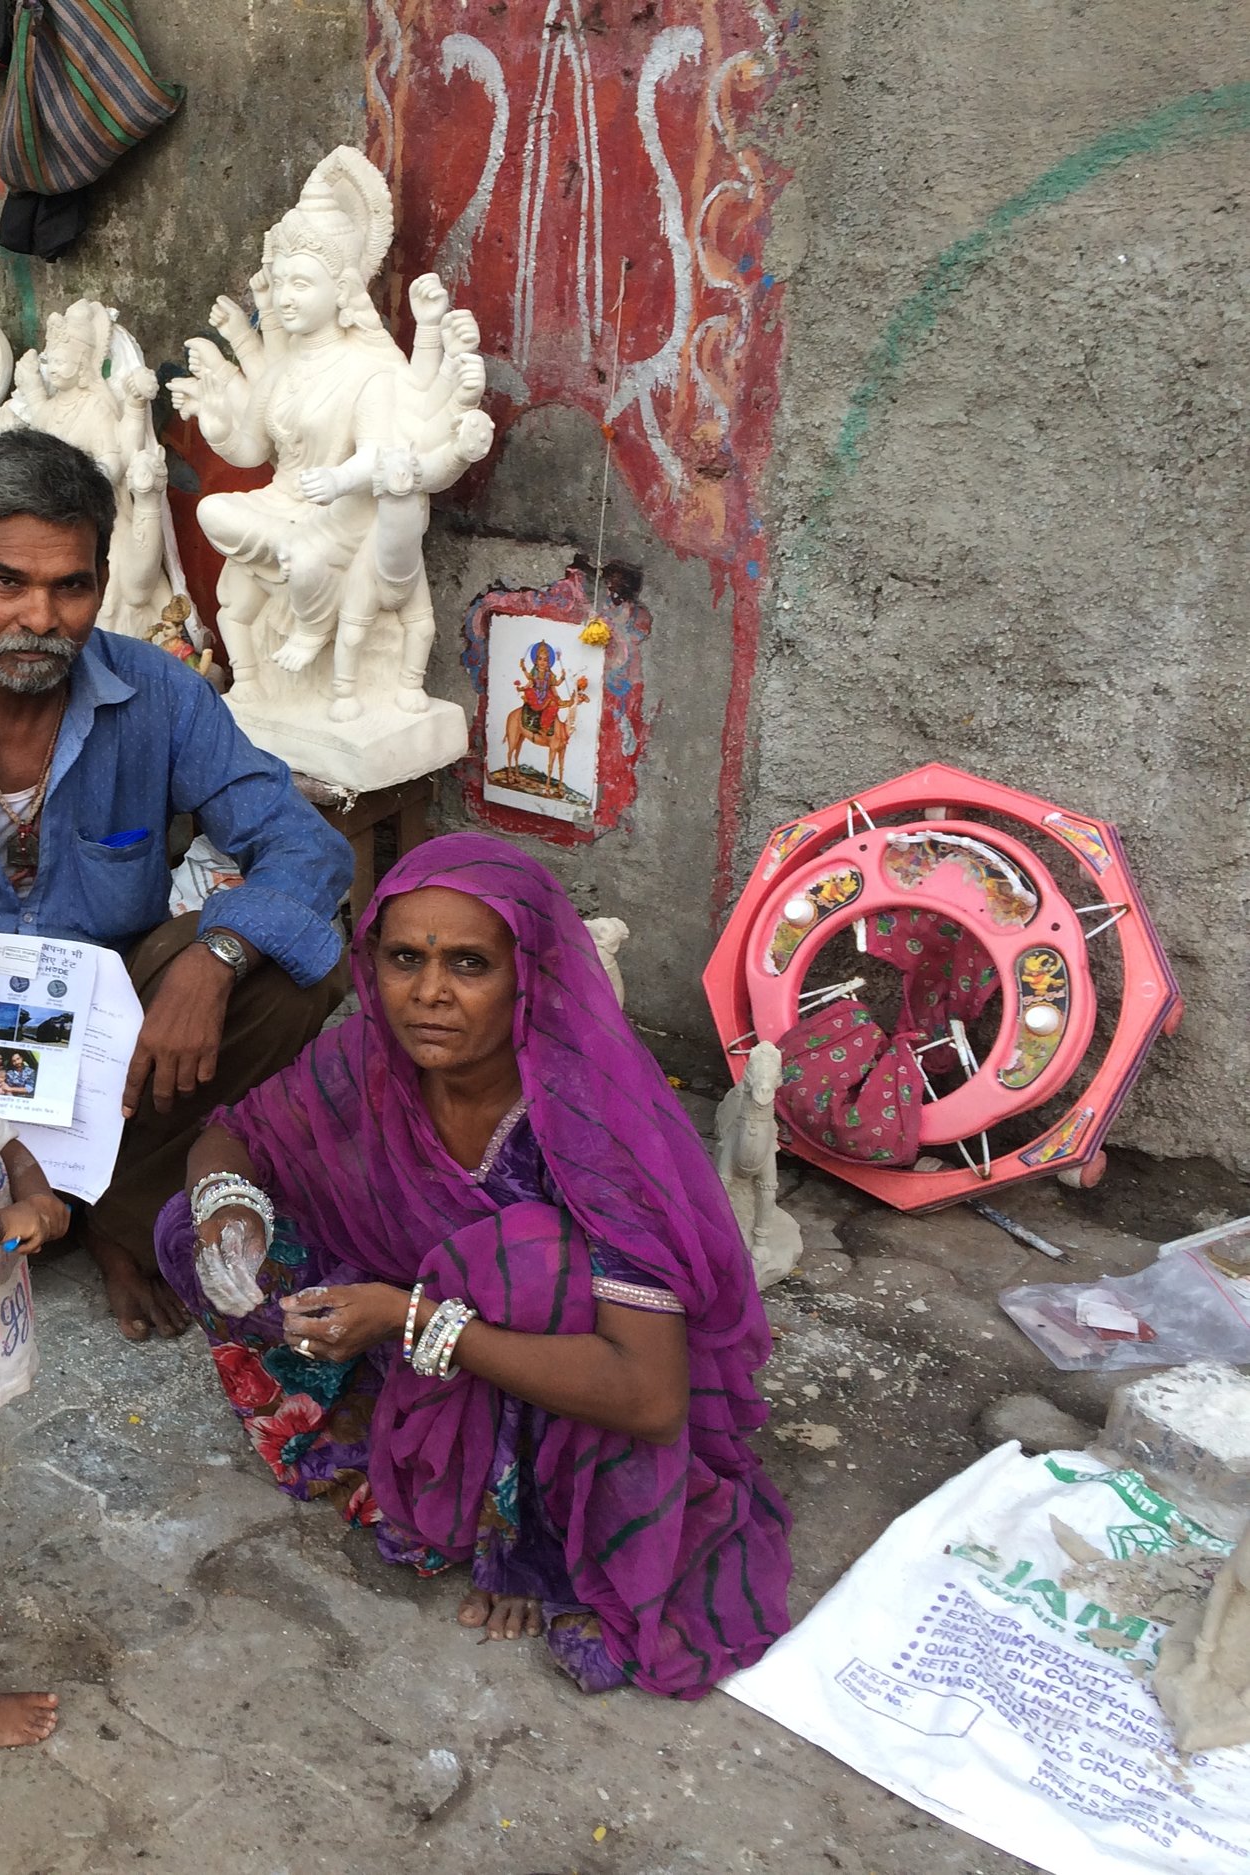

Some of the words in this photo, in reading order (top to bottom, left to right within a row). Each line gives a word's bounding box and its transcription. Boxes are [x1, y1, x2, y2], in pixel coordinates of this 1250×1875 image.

[1006, 1668, 1102, 1715] SURFACE
[1022, 1633, 1135, 1685] AESTHETIC
[1030, 1648, 1117, 1691] QUALITY
[916, 1657, 960, 1672] SETS
[1079, 1741, 1149, 1779] SAVES
[1020, 1690, 1082, 1721] LIGHT
[1045, 1668, 1160, 1731] COVERAGE
[908, 1669, 935, 1683] NO
[938, 1676, 1021, 1730] WASTAGE
[1042, 1742, 1073, 1763] NO
[1079, 1757, 1169, 1801] CRACKS
[1029, 1776, 1065, 1801] DRY
[1067, 1801, 1173, 1849] CONDITIONS
[1037, 1766, 1086, 1803] WHEN
[1088, 1799, 1159, 1826] STORED
[1162, 1821, 1181, 1838] IN
[1088, 1783, 1159, 1814] BEFORE
[1175, 1815, 1250, 1857] MONTHS
